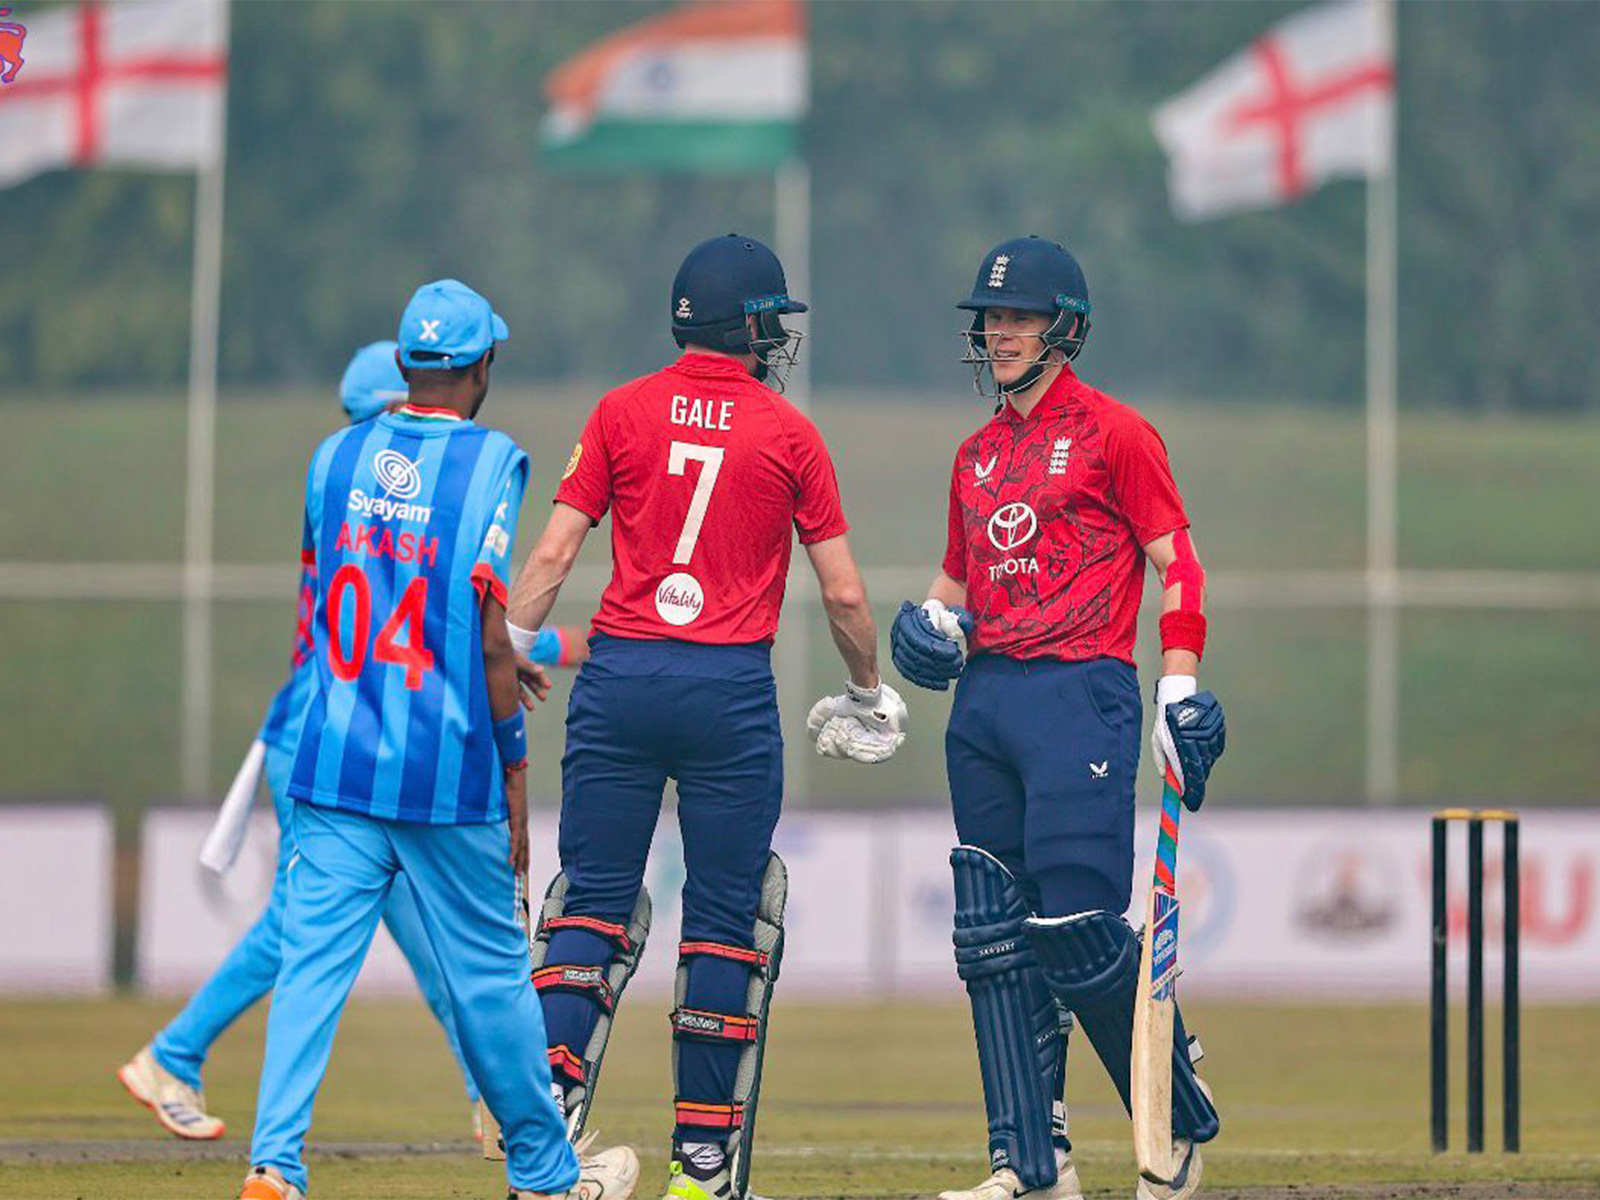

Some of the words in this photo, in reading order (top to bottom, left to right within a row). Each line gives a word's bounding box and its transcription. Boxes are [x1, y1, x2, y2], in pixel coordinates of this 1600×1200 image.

[670, 394, 735, 431] GALE
[347, 488, 431, 524] Svayam
[667, 439, 726, 566] 7
[334, 520, 439, 567] AKASH
[658, 584, 702, 615] Vitality
[326, 562, 435, 691] 04
